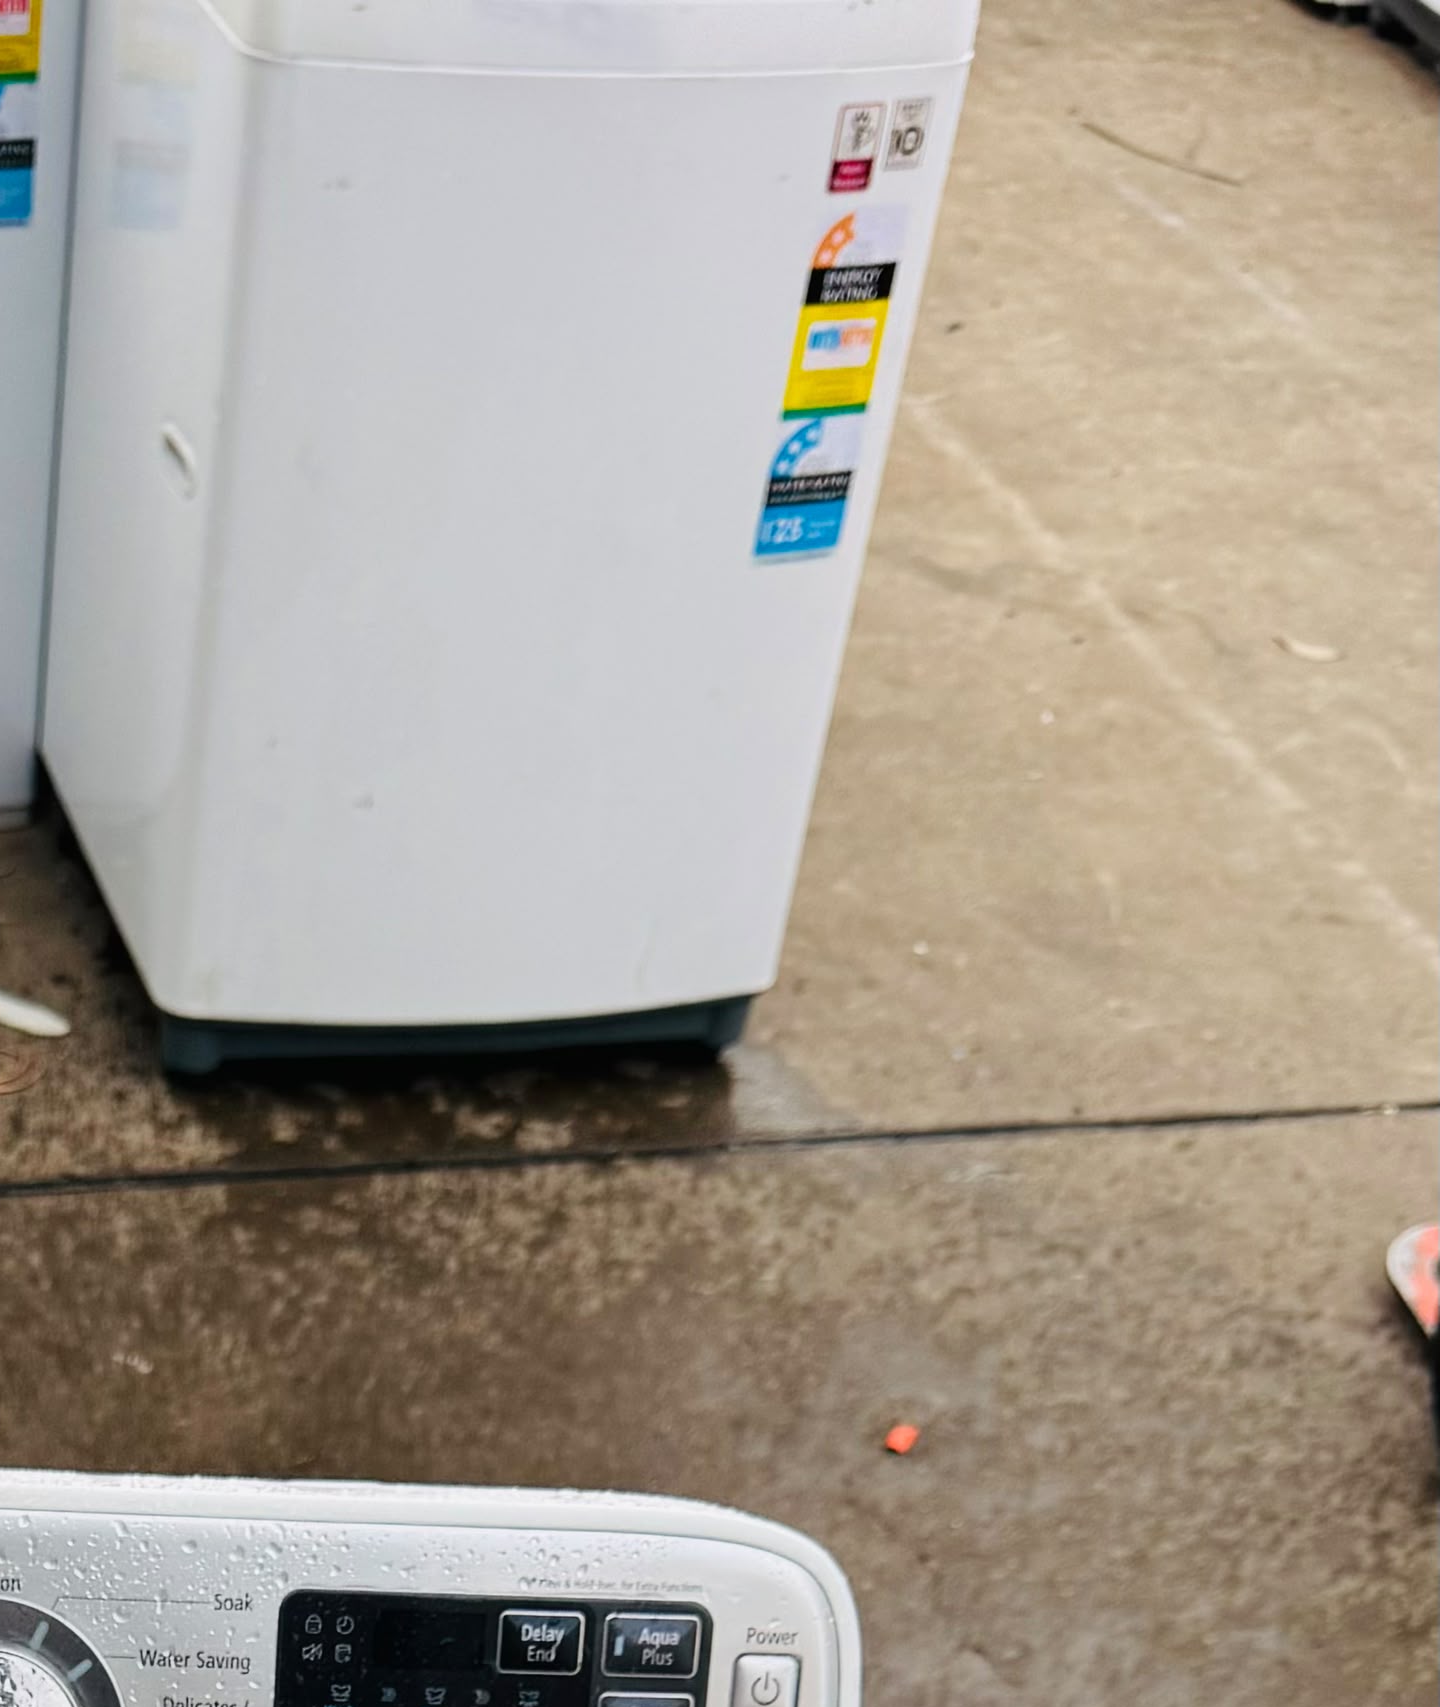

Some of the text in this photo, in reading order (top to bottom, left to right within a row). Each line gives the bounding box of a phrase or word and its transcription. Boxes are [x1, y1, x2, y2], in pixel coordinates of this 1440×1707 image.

[213, 1593, 254, 1611] Soak
[521, 1623, 565, 1647] Delay
[638, 1628, 681, 1649] Aqua
[746, 1626, 799, 1647] Power
[139, 1649, 251, 1675] Water Saving
[526, 1645, 557, 1663] End
[641, 1648, 674, 1666] Plus
